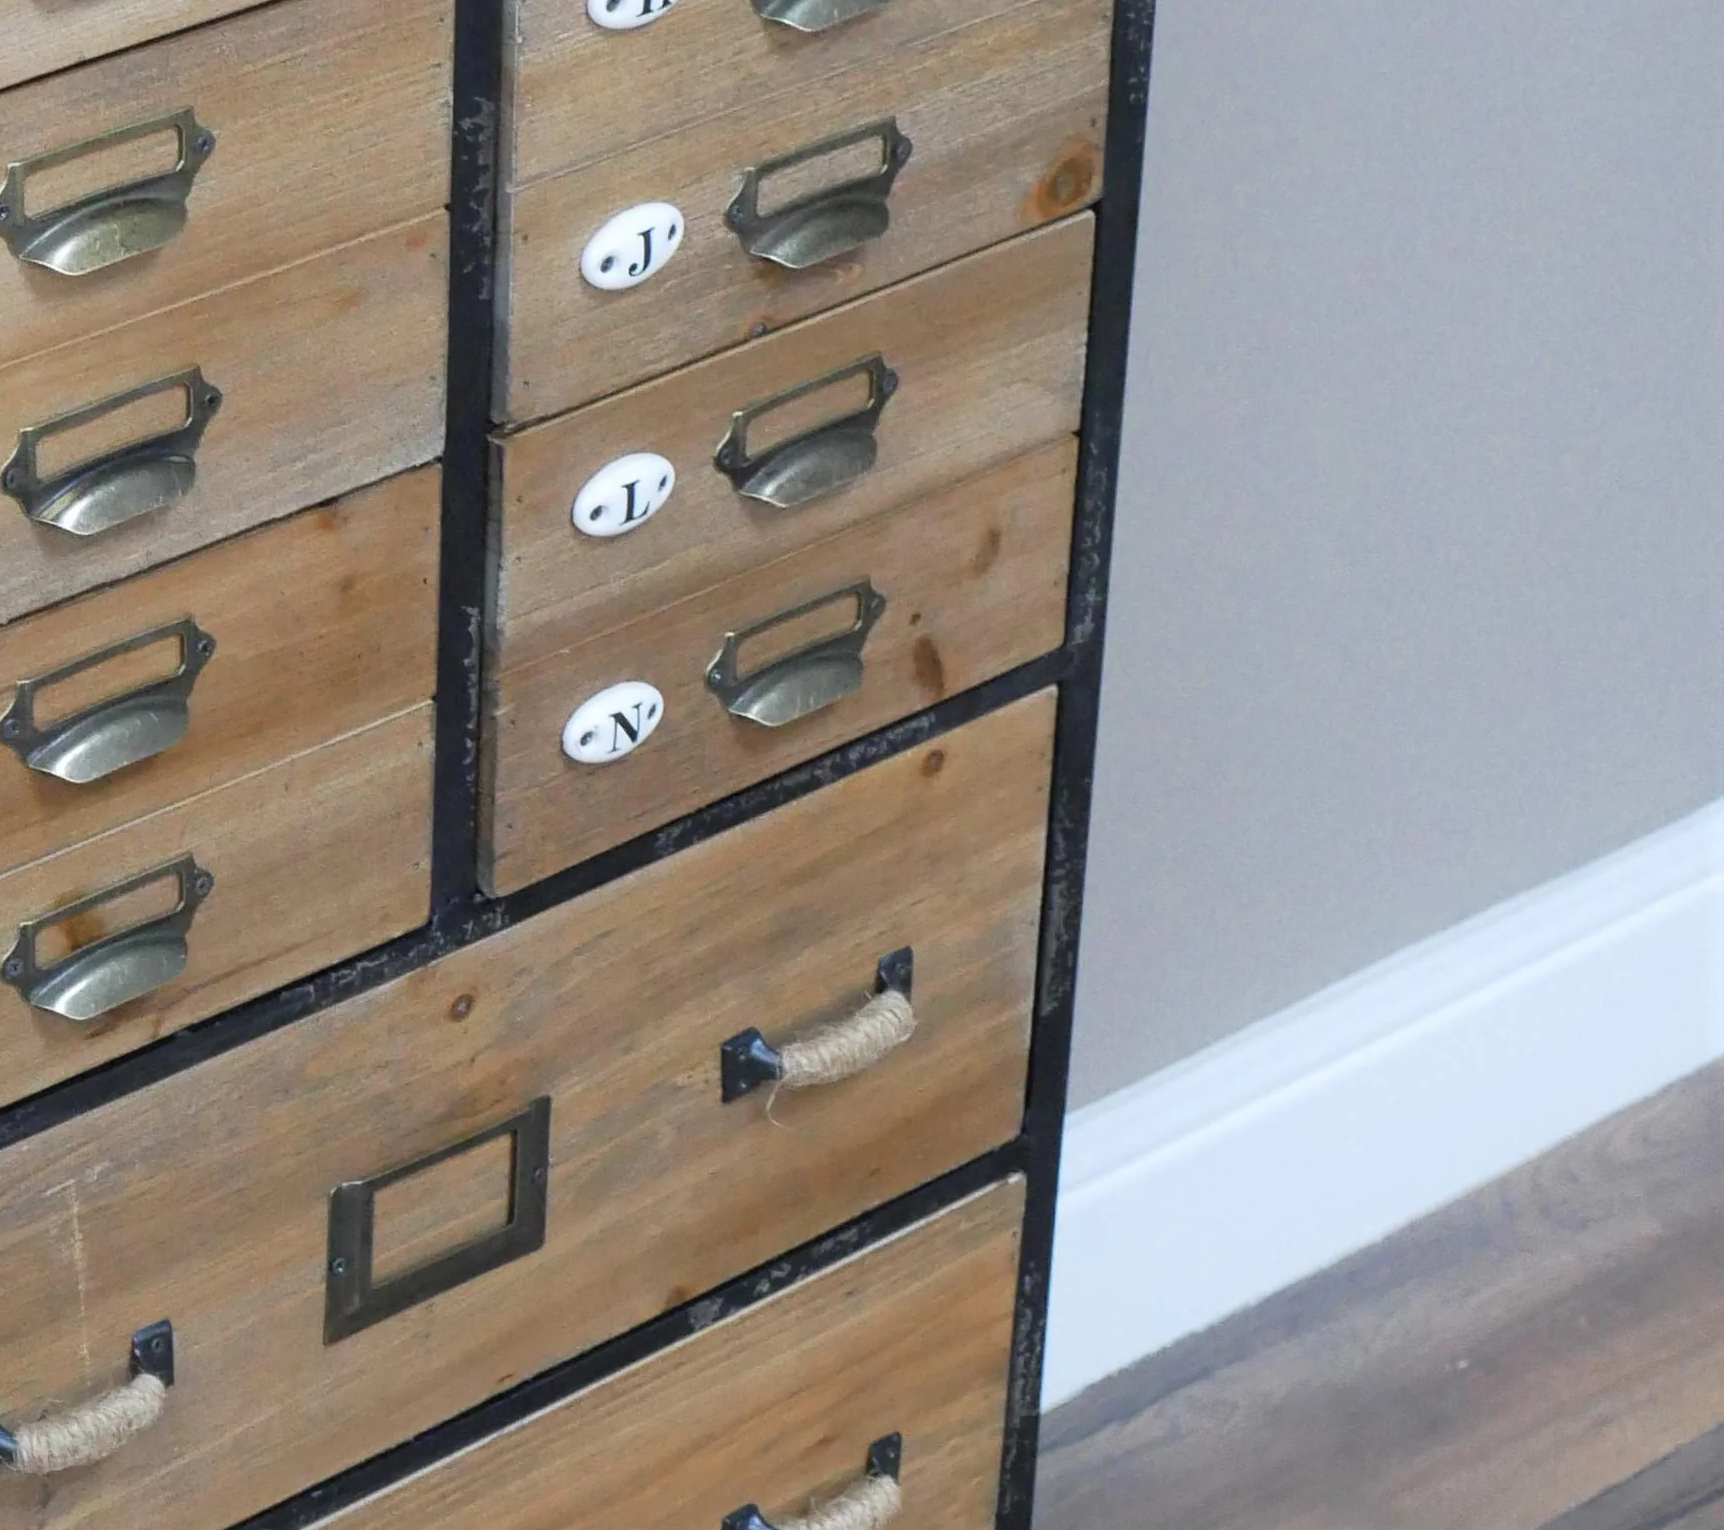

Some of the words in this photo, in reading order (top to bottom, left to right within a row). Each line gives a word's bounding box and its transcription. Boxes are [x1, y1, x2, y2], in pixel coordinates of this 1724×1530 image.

[629, 227, 653, 278] J
[620, 479, 648, 525] L
[607, 703, 642, 753] N
